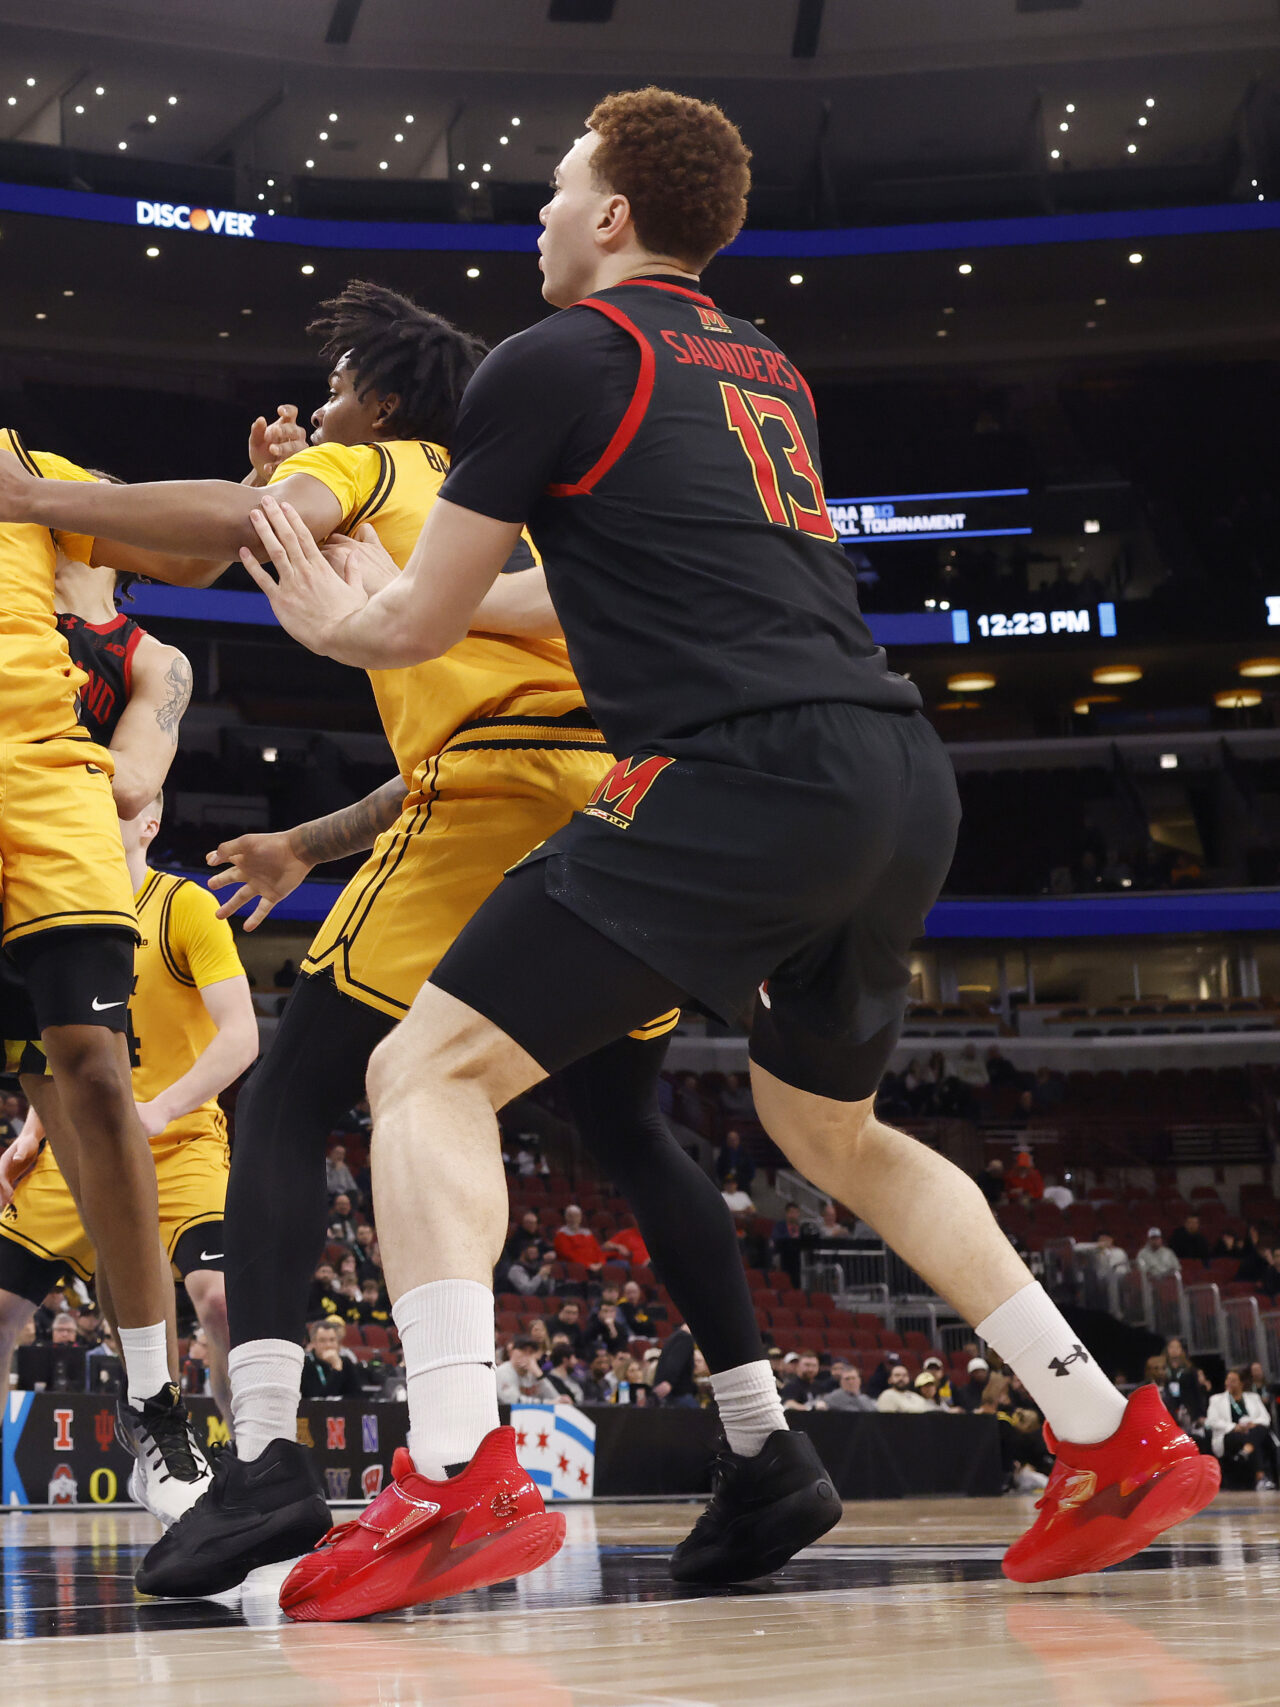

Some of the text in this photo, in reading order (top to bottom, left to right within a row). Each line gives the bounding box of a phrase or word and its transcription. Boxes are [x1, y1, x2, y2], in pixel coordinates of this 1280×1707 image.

[136, 200, 257, 238] DISCOVER
[660, 330, 798, 392] SAUNDERS
[718, 380, 838, 543] 13
[861, 513, 966, 534] TOURNAMENT
[977, 610, 1090, 637] 12:23 PM
